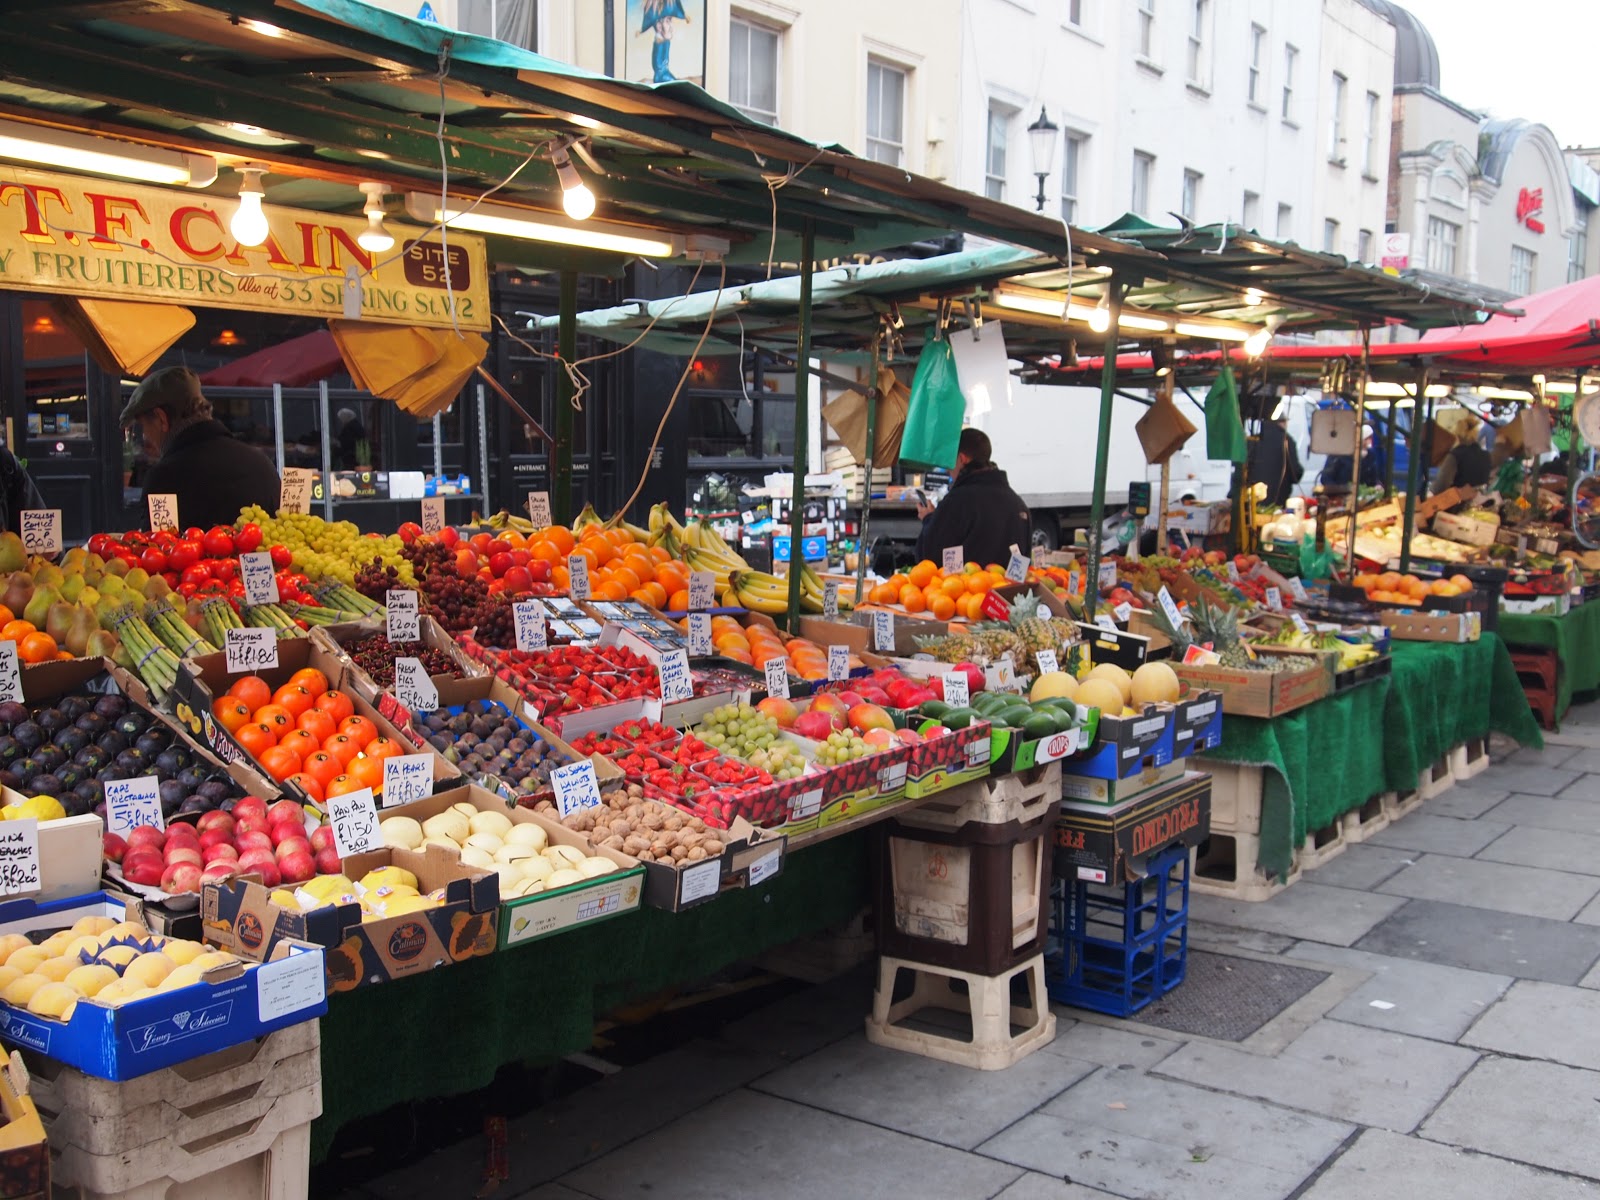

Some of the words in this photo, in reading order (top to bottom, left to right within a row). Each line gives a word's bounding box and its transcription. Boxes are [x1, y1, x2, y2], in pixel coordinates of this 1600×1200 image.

[170, 207, 377, 281] CAIN
[411, 247, 460, 266] SITE
[32, 252, 235, 295] FRUITERERS
[237, 276, 261, 295] Also
[263, 281, 279, 300] at
[280, 278, 312, 302] 33
[422, 265, 453, 283] 52
[519, 464, 546, 472] ENTRANCE
[1049, 735, 1070, 758] TROPS
[402, 762, 426, 777] PEARS
[107, 783, 129, 797] CAPE
[1132, 799, 1200, 857] FRUCIMU
[390, 936, 425, 955] Caliman
